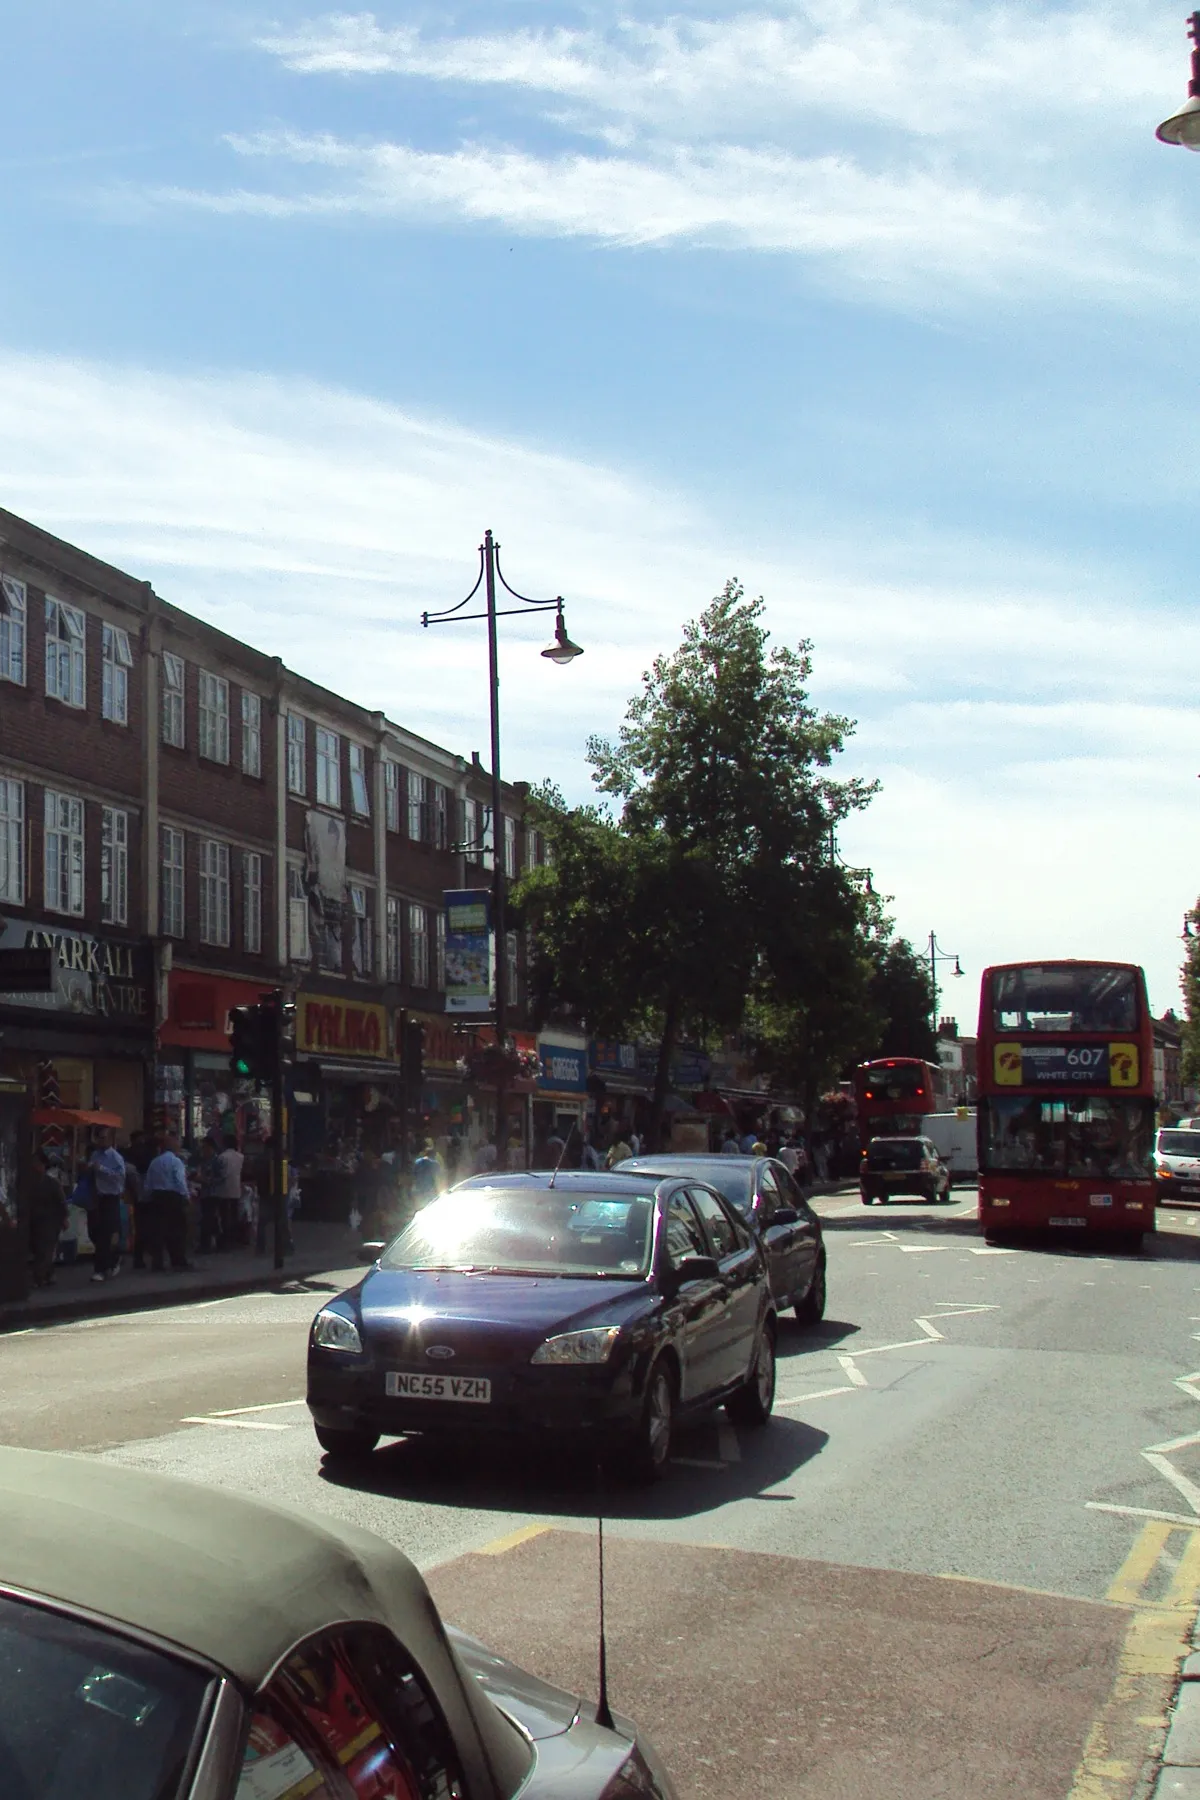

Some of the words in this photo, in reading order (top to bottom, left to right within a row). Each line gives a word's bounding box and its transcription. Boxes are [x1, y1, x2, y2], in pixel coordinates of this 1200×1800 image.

[1067, 1048, 1105, 1065] 607
[1036, 1071, 1068, 1080] WHITE
[1072, 1071, 1095, 1080] CITY
[451, 1377, 488, 1400] VZH
